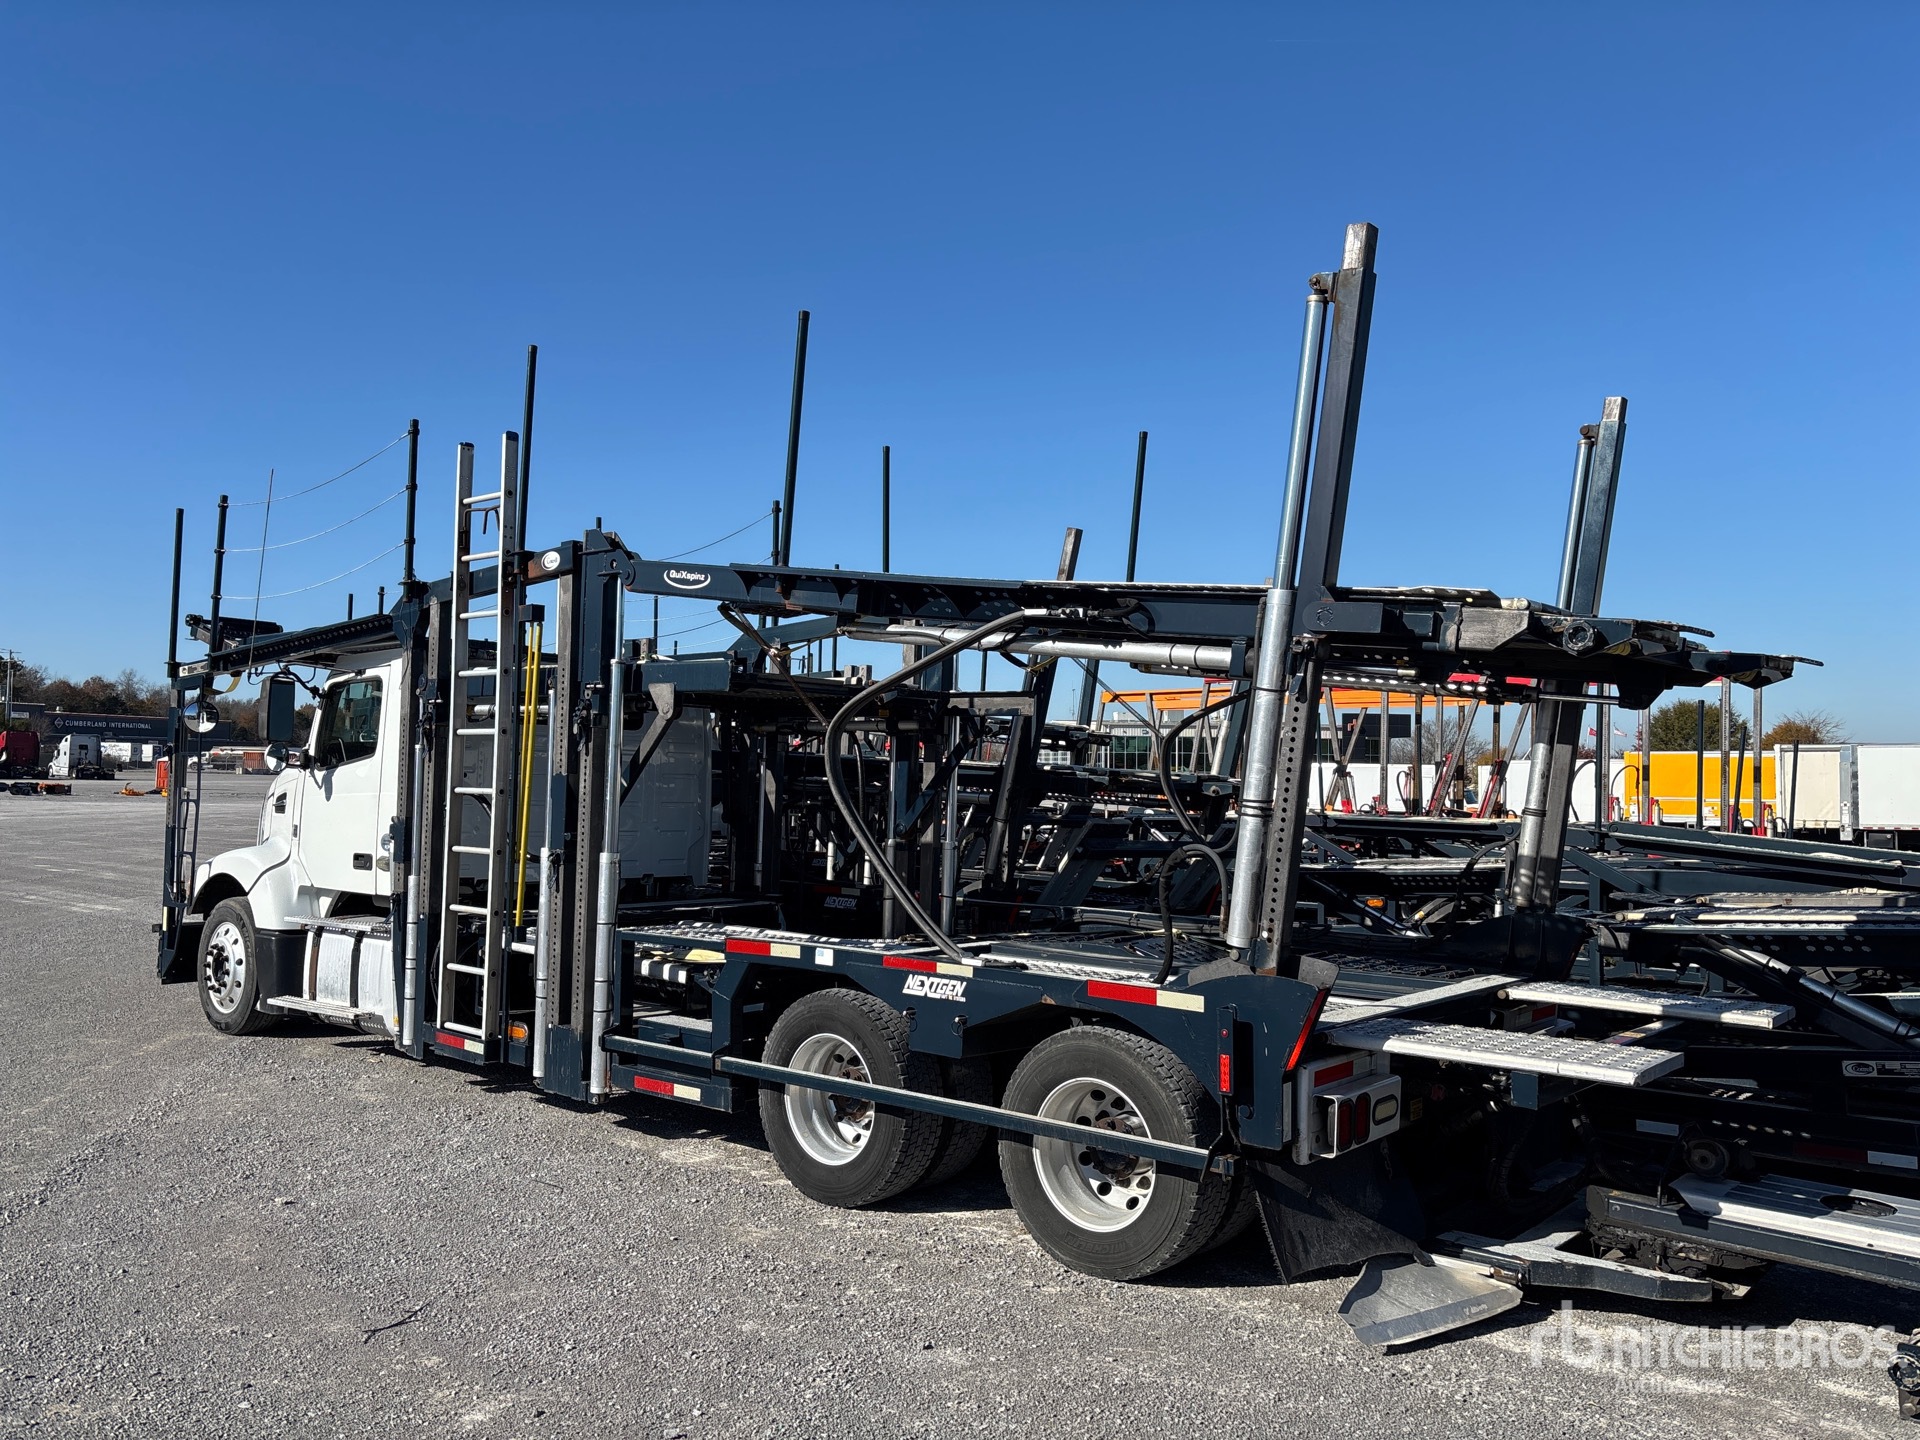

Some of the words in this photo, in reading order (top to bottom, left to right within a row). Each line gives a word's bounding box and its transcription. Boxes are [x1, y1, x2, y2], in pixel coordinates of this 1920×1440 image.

[825, 896, 858, 908] NEXTGEN
[902, 974, 967, 999] NEXTGEN
[1066, 1235, 1125, 1254] MICHELIN
